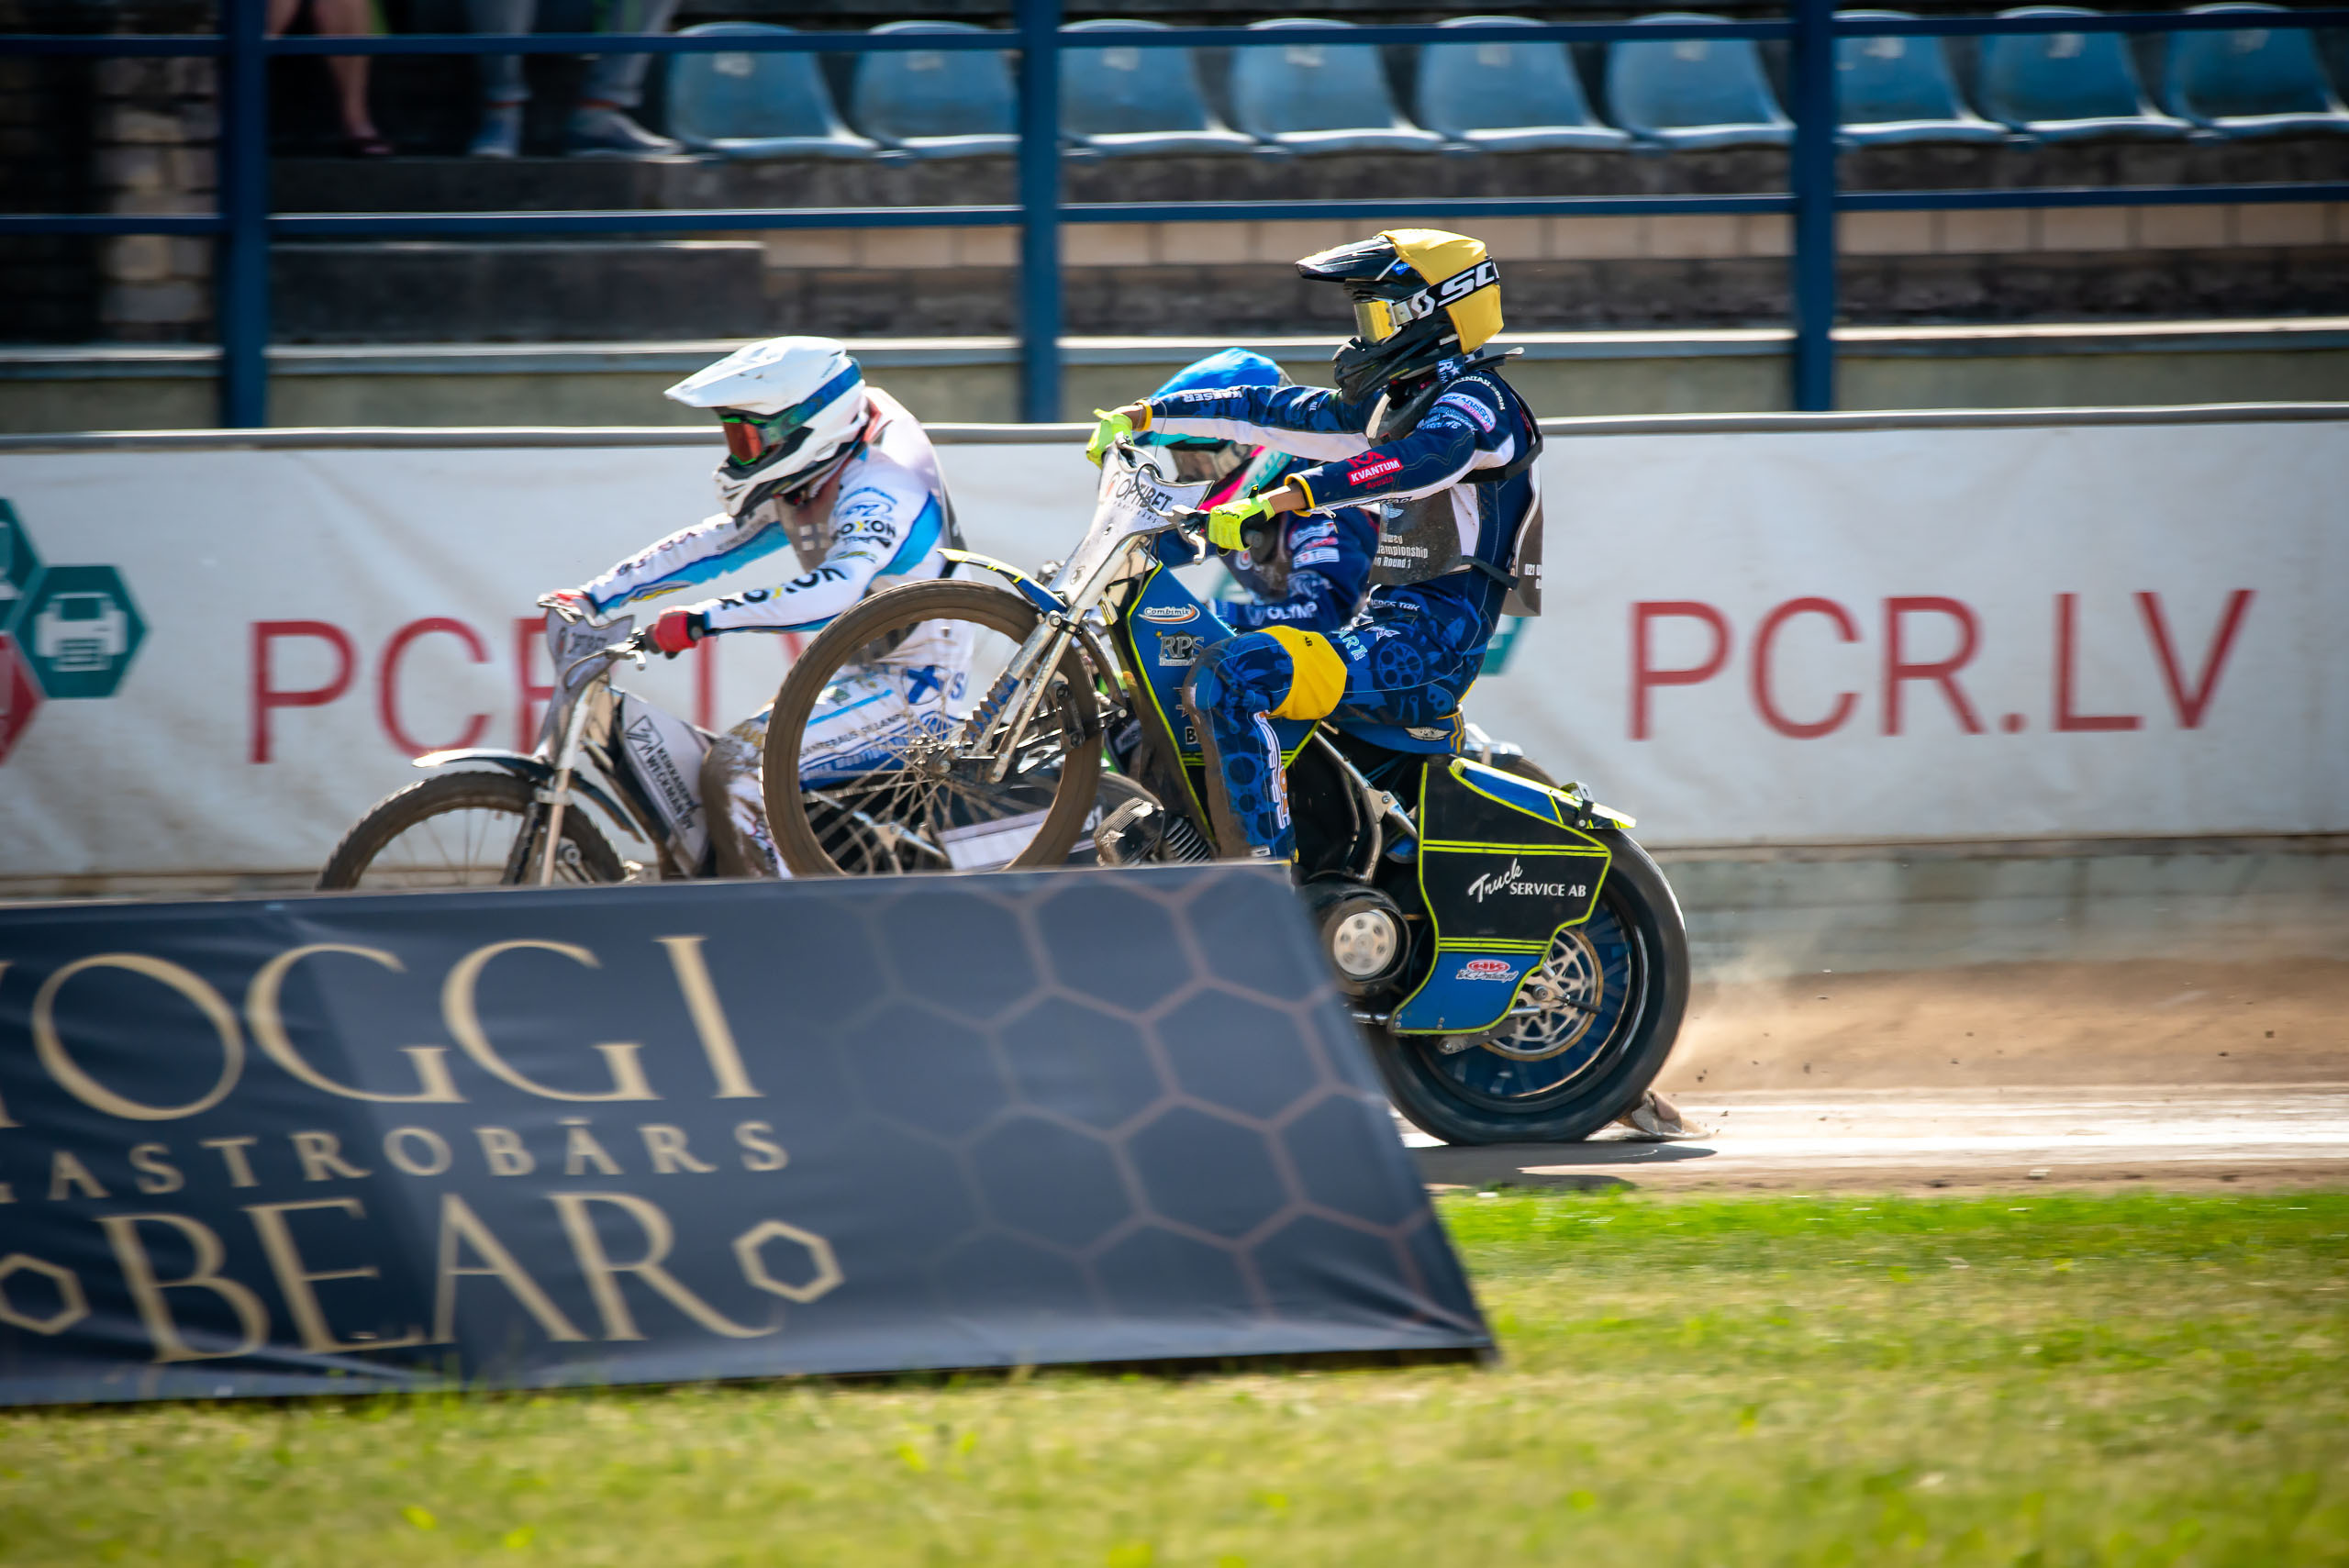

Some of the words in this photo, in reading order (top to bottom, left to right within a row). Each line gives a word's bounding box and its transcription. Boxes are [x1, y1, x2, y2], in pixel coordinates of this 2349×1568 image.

[1438, 261, 1499, 307] SC
[1351, 460, 1400, 483] KVANTUM
[1383, 556, 1407, 569] Round
[1407, 559, 1412, 569] 1
[1144, 606, 1192, 617] Combimix
[1159, 636, 1205, 660] RPS
[1624, 588, 2259, 741] PCR.LV
[1467, 857, 1524, 904] Truck
[1509, 882, 1565, 897] SERVICE
[1567, 884, 1587, 898] AB
[94, 1192, 783, 1364] BEAR
